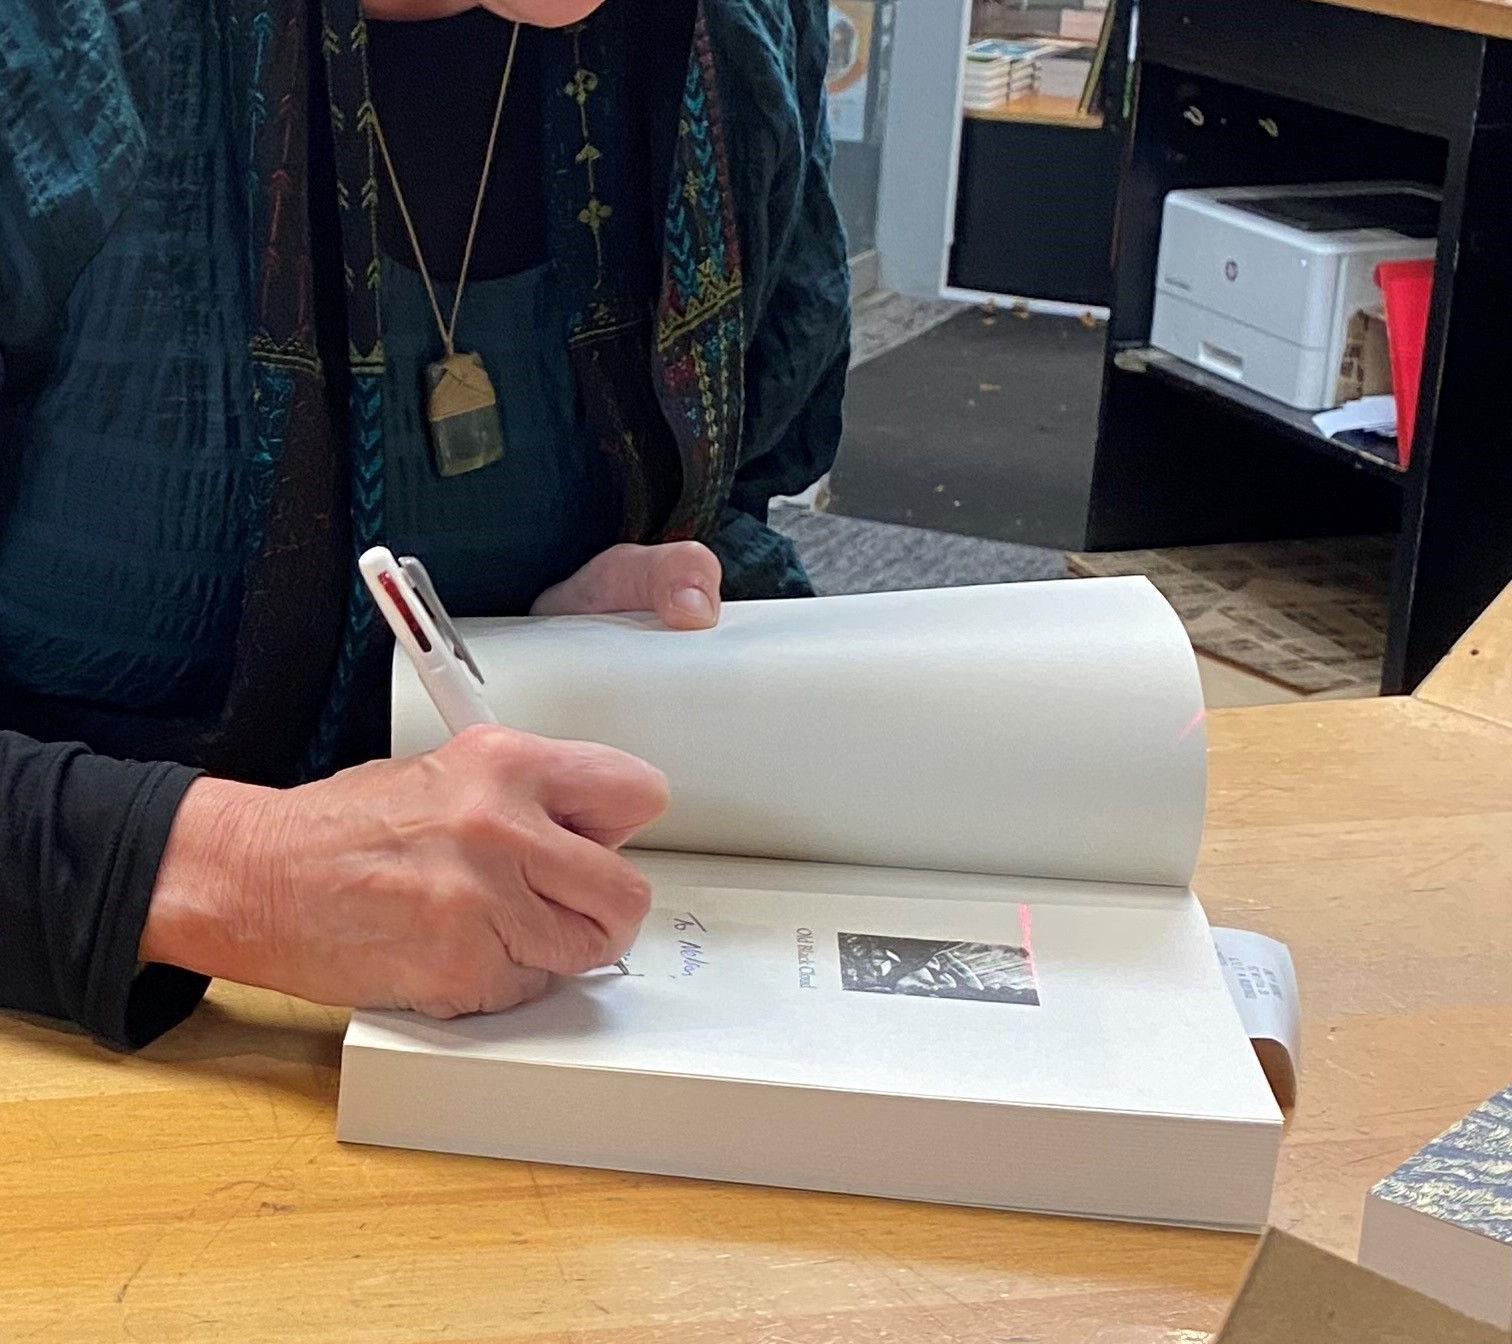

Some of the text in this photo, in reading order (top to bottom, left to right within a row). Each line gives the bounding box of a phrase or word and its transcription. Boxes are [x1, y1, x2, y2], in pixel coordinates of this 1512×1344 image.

[673, 911, 707, 934] To
[795, 926, 815, 945] Old
[798, 965, 818, 990] Cloud
